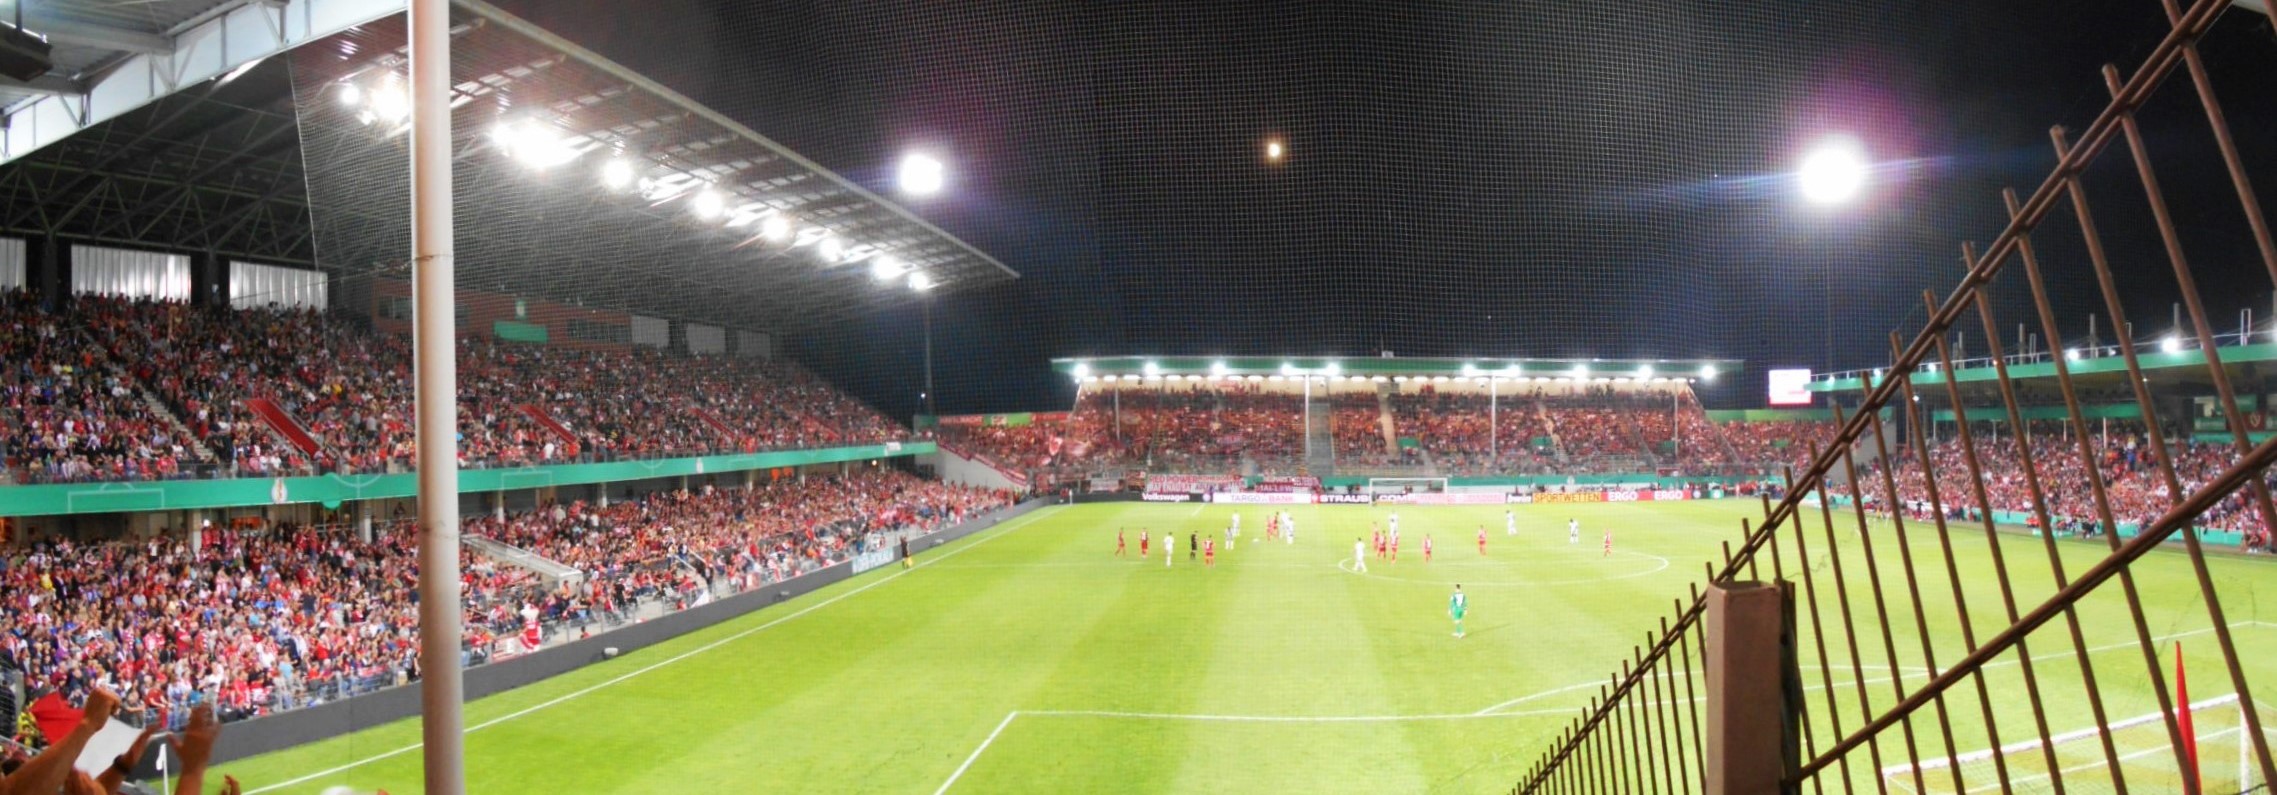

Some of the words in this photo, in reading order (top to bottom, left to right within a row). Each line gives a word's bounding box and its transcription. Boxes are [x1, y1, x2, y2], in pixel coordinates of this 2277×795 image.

[1142, 493, 1190, 502] Volkswagen
[1534, 492, 1600, 502] SPORTWETTEN
[1608, 491, 1638, 501] ERGO
[1653, 490, 1683, 500] ERGO
